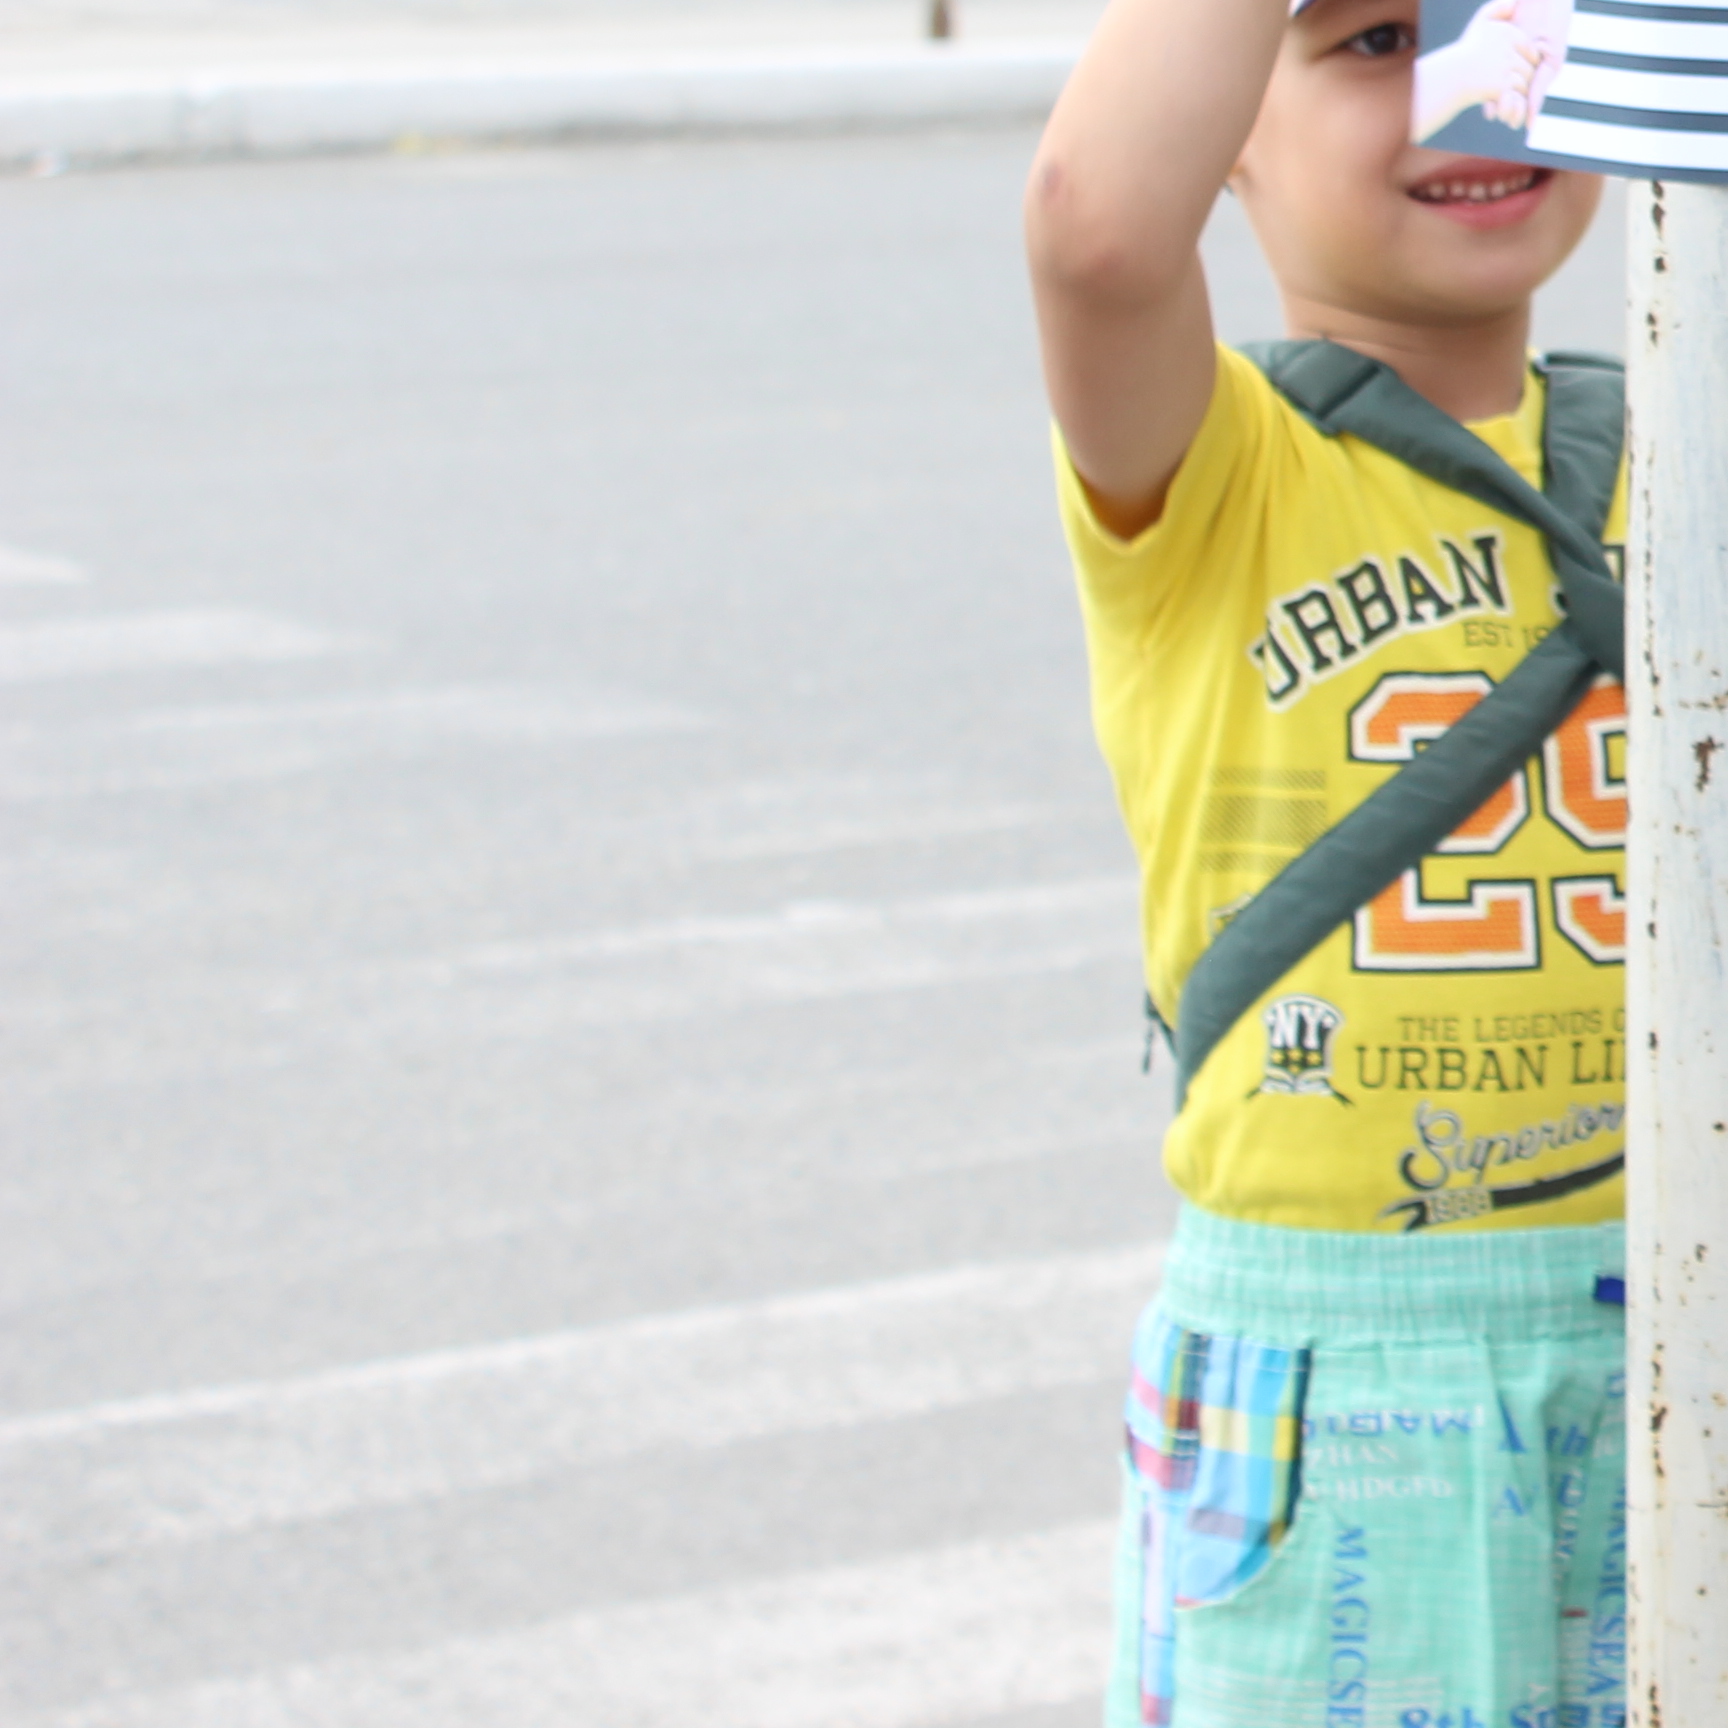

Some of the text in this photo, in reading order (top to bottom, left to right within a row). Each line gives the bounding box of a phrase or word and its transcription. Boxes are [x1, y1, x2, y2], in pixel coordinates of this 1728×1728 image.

[1250, 532, 1509, 706] URBAN
[1463, 622, 1513, 648] EST
[1266, 1001, 1334, 1049] NY
[1398, 1016, 1460, 1043] THE
[1473, 1010, 1603, 1043] LEGENDS
[1356, 1038, 1625, 1092] URBAN LI
